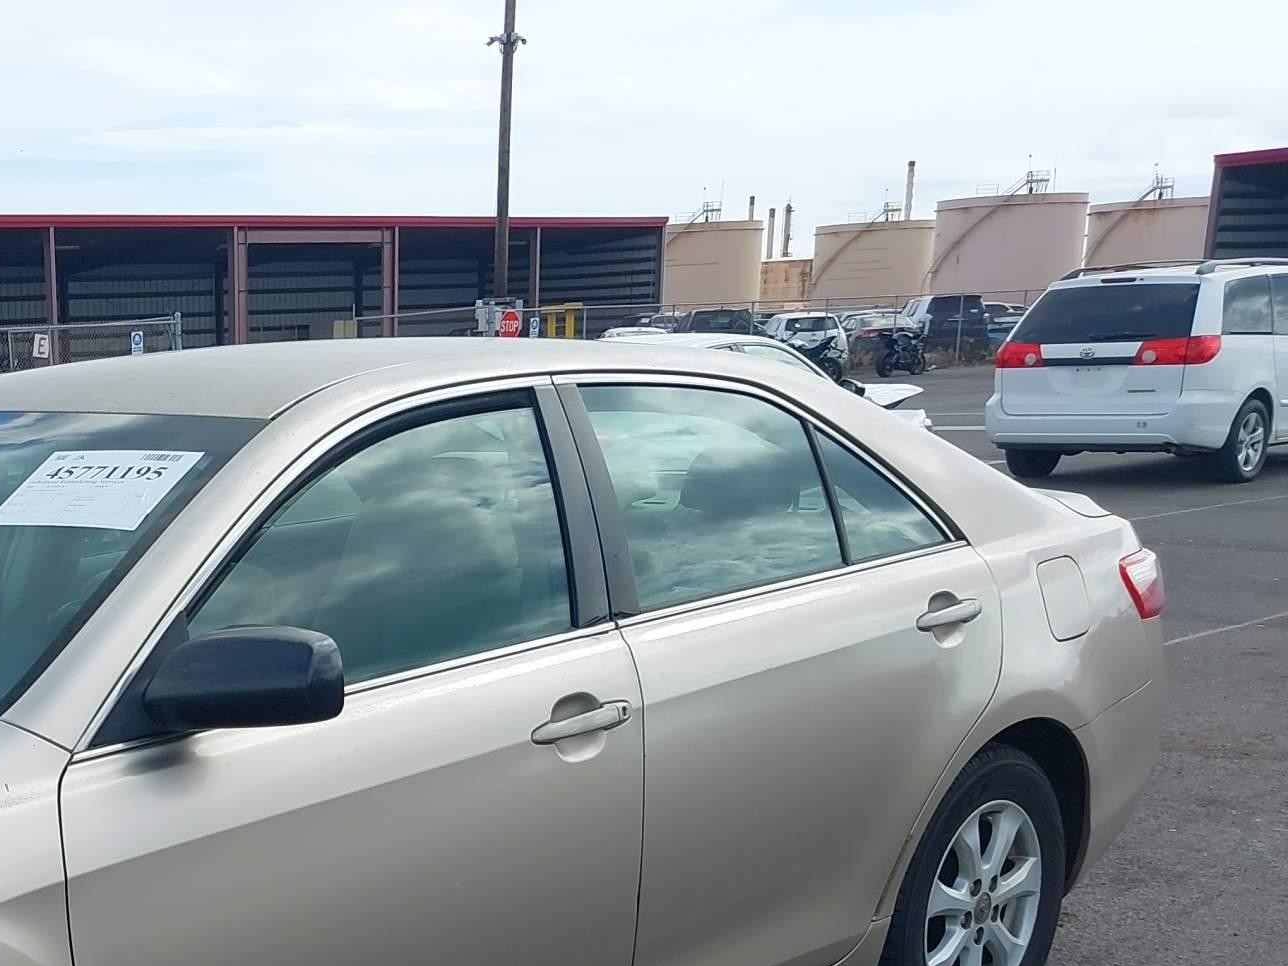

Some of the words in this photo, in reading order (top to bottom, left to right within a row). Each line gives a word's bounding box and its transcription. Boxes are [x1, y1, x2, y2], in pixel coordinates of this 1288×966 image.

[501, 320, 519, 333] STOP
[38, 337, 47, 355] E
[46, 466, 168, 480] 45771195
